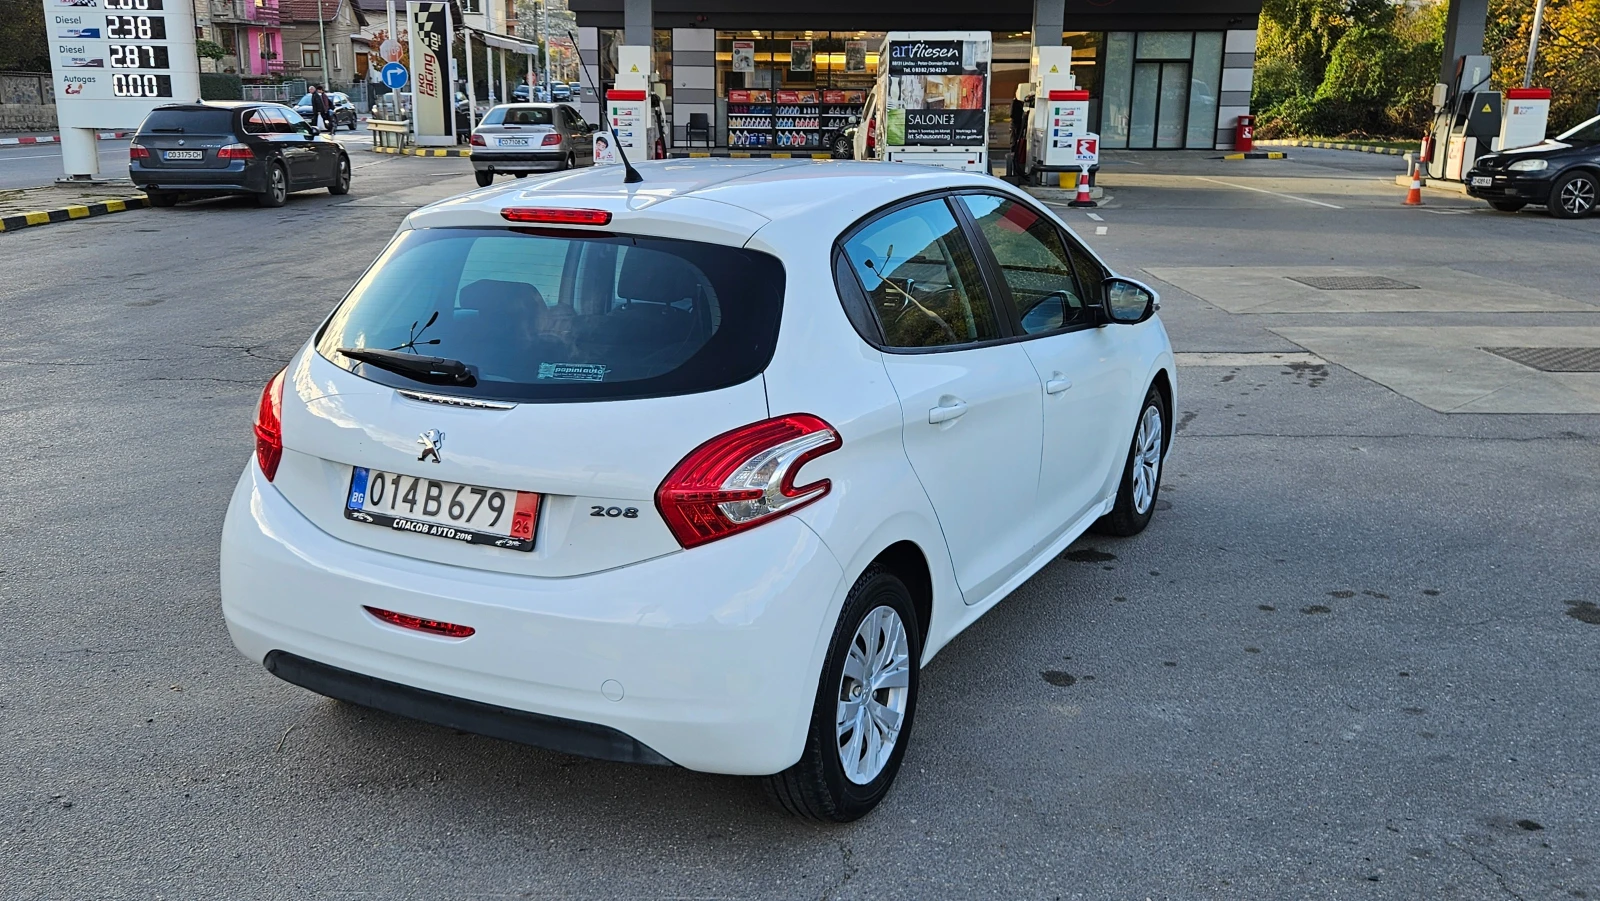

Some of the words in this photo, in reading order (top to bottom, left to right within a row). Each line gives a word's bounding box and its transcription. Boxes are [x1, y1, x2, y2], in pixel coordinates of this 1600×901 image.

[56, 16, 81, 24] Diesel
[107, 16, 152, 39] 2.38
[430, 32, 440, 51] 100
[60, 46, 85, 54] Diesel
[110, 45, 156, 67] 2.87
[892, 43, 959, 58] artfliesen
[63, 75, 96, 84] Autogas
[424, 52, 436, 97] racing
[113, 75, 158, 97] 0.00
[418, 73, 426, 95] EKO
[908, 114, 949, 125] SALONE
[352, 492, 365, 503] BG
[590, 505, 639, 518] 208
[393, 519, 429, 533] СПАСОВ
[430, 527, 455, 539] АУТО
[456, 532, 473, 541] 2016
[514, 519, 530, 535] 26
